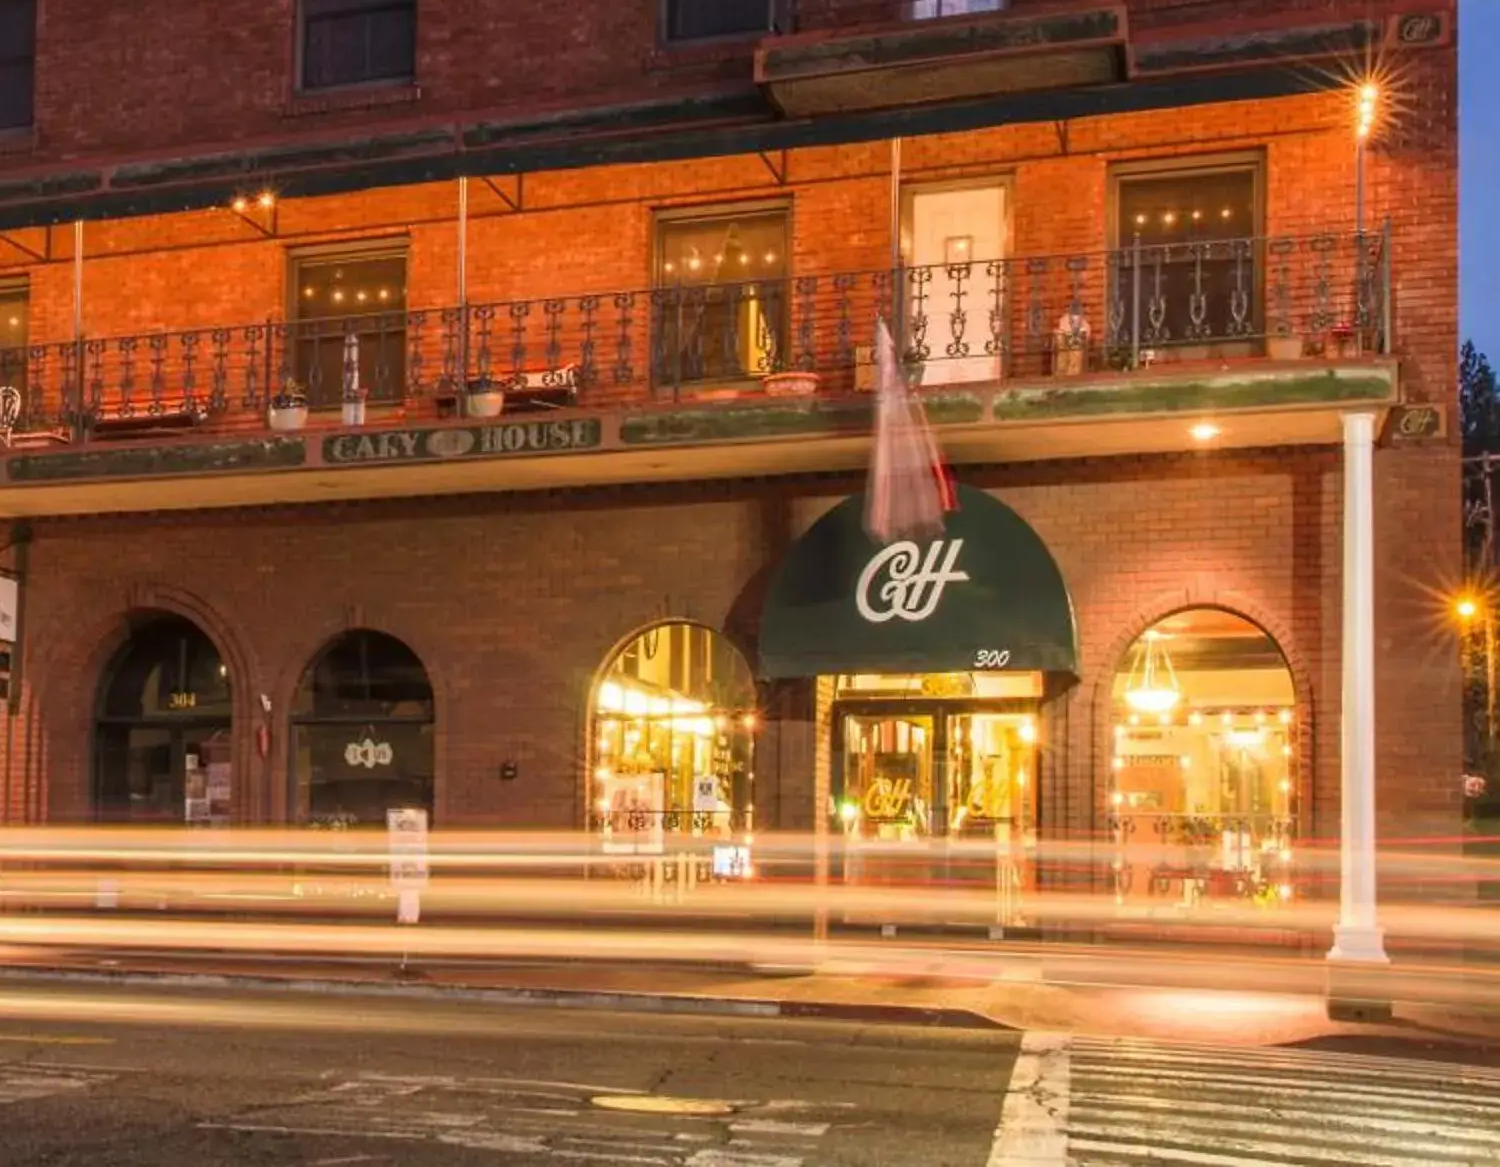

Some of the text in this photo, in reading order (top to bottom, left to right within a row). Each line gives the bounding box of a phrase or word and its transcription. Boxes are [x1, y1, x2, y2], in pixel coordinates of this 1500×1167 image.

[332, 433, 419, 461] CARY
[480, 420, 590, 453] HOUSE
[973, 649, 1012, 668] 300
